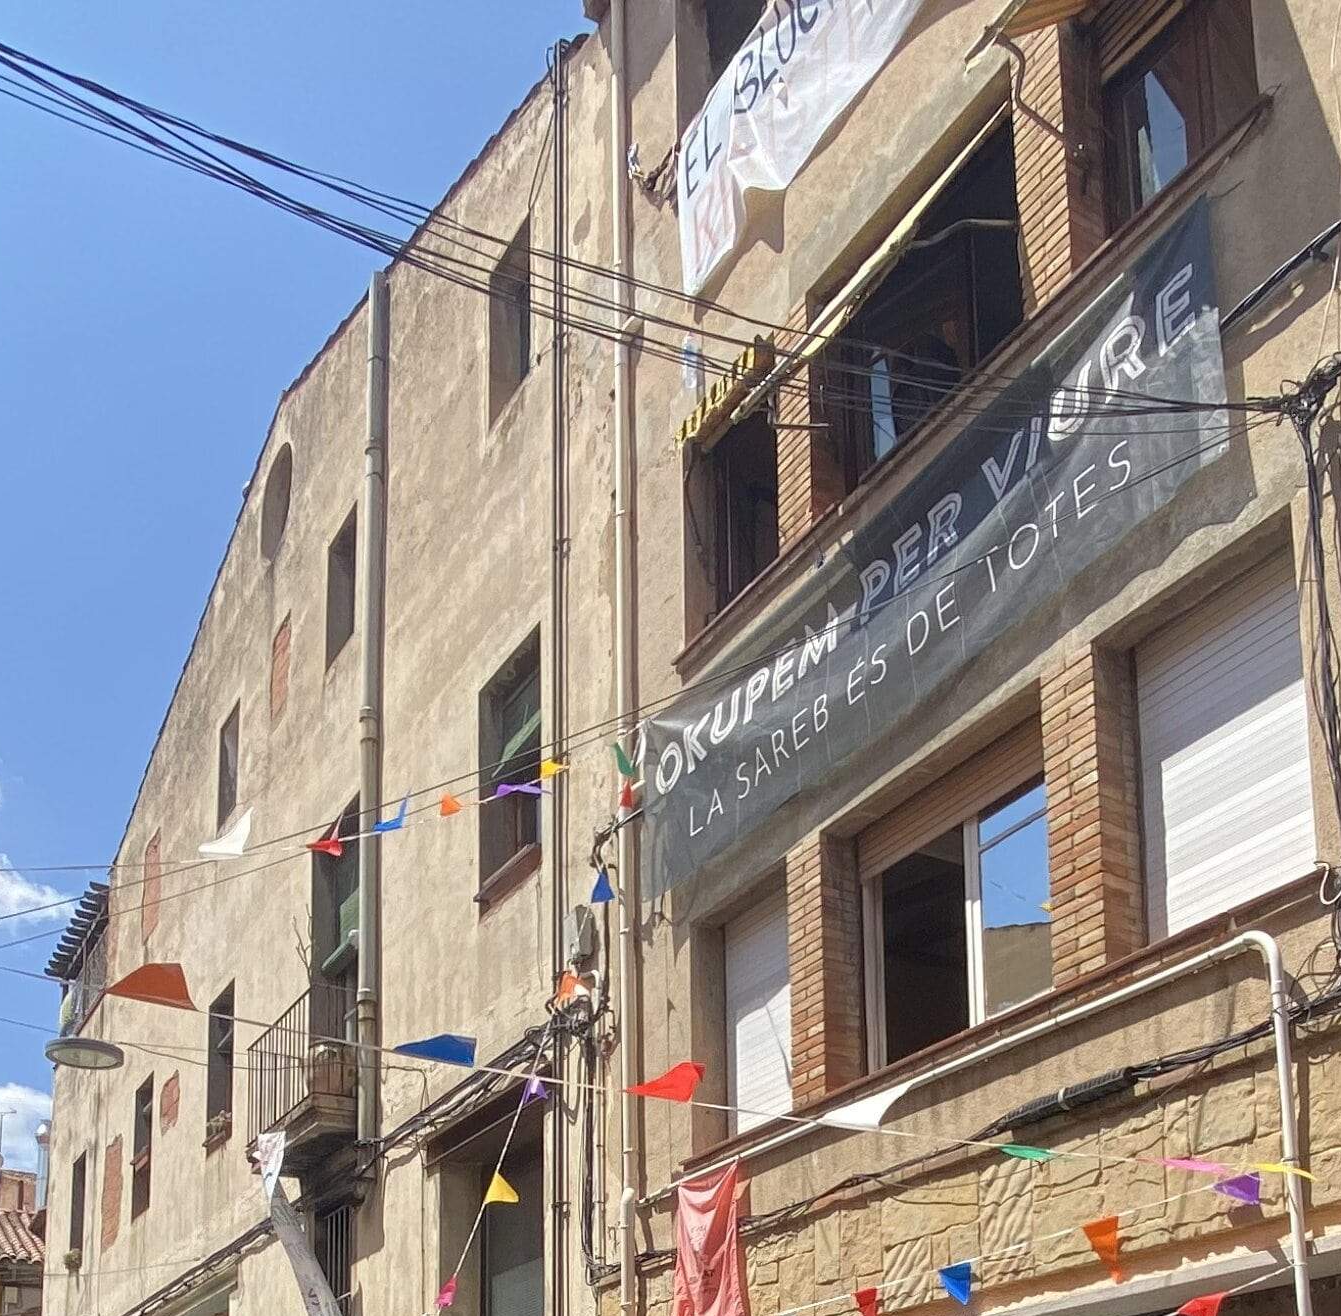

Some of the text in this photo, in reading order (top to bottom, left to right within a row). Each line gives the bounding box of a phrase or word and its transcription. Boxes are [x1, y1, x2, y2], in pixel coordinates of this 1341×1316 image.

[685, 114, 723, 199] EL
[655, 601, 858, 796] OKUPEM
[859, 491, 962, 627] PER
[689, 439, 1132, 838] LA SAREB ÉS DE TOTES
